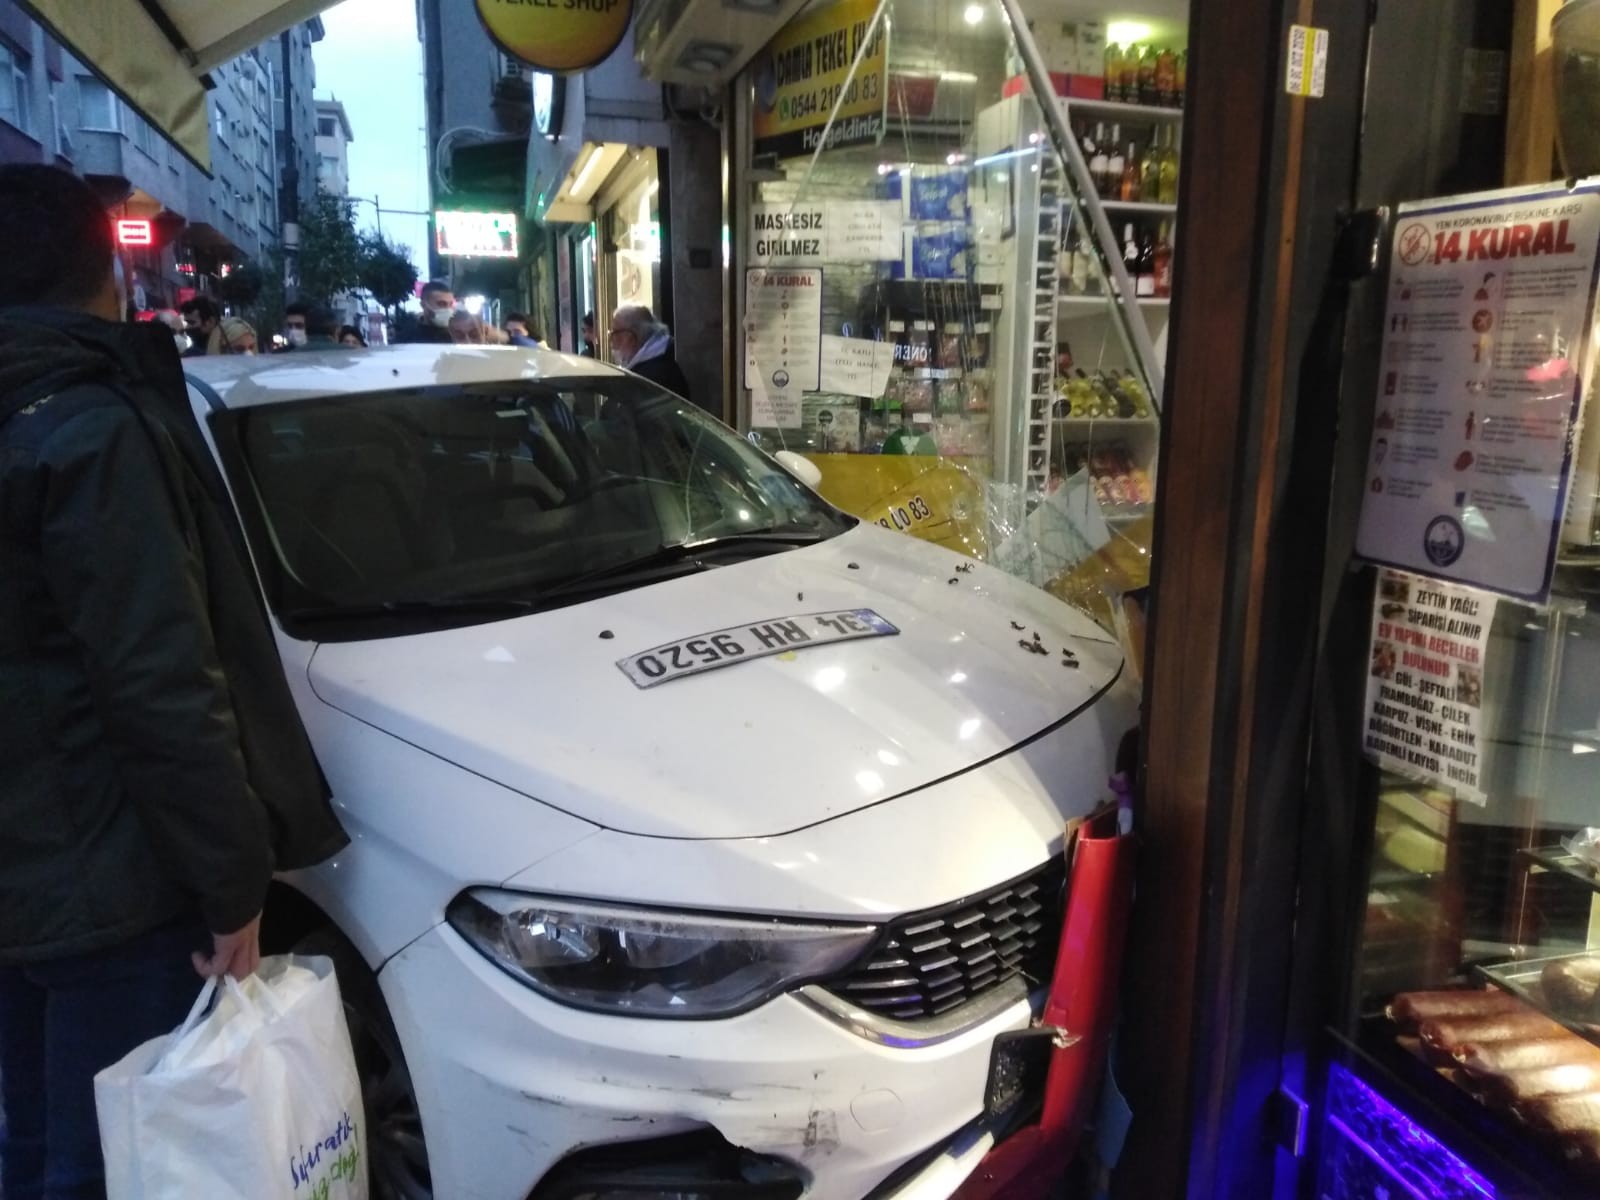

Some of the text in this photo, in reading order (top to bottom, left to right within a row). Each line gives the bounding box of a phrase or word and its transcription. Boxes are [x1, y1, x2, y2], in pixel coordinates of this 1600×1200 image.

[815, 28, 848, 76] TEKEL
[791, 92, 817, 120] 0544
[863, 73, 878, 100] 83
[803, 115, 880, 150] Hogeldiniz
[755, 208, 822, 230] MASKESİZ
[1434, 219, 1576, 265] 14 KURAL
[777, 275, 814, 287] KURAL
[908, 496, 929, 520] 83
[1416, 590, 1448, 610] ZEYTİN
[749, 620, 811, 648] RH
[815, 612, 871, 635] 34
[1378, 622, 1393, 639] EV
[1447, 618, 1482, 640] ALINIR
[636, 633, 745, 678] 9520
[1374, 701, 1409, 724] KARPUZ
[1429, 739, 1478, 767] KARADUT
